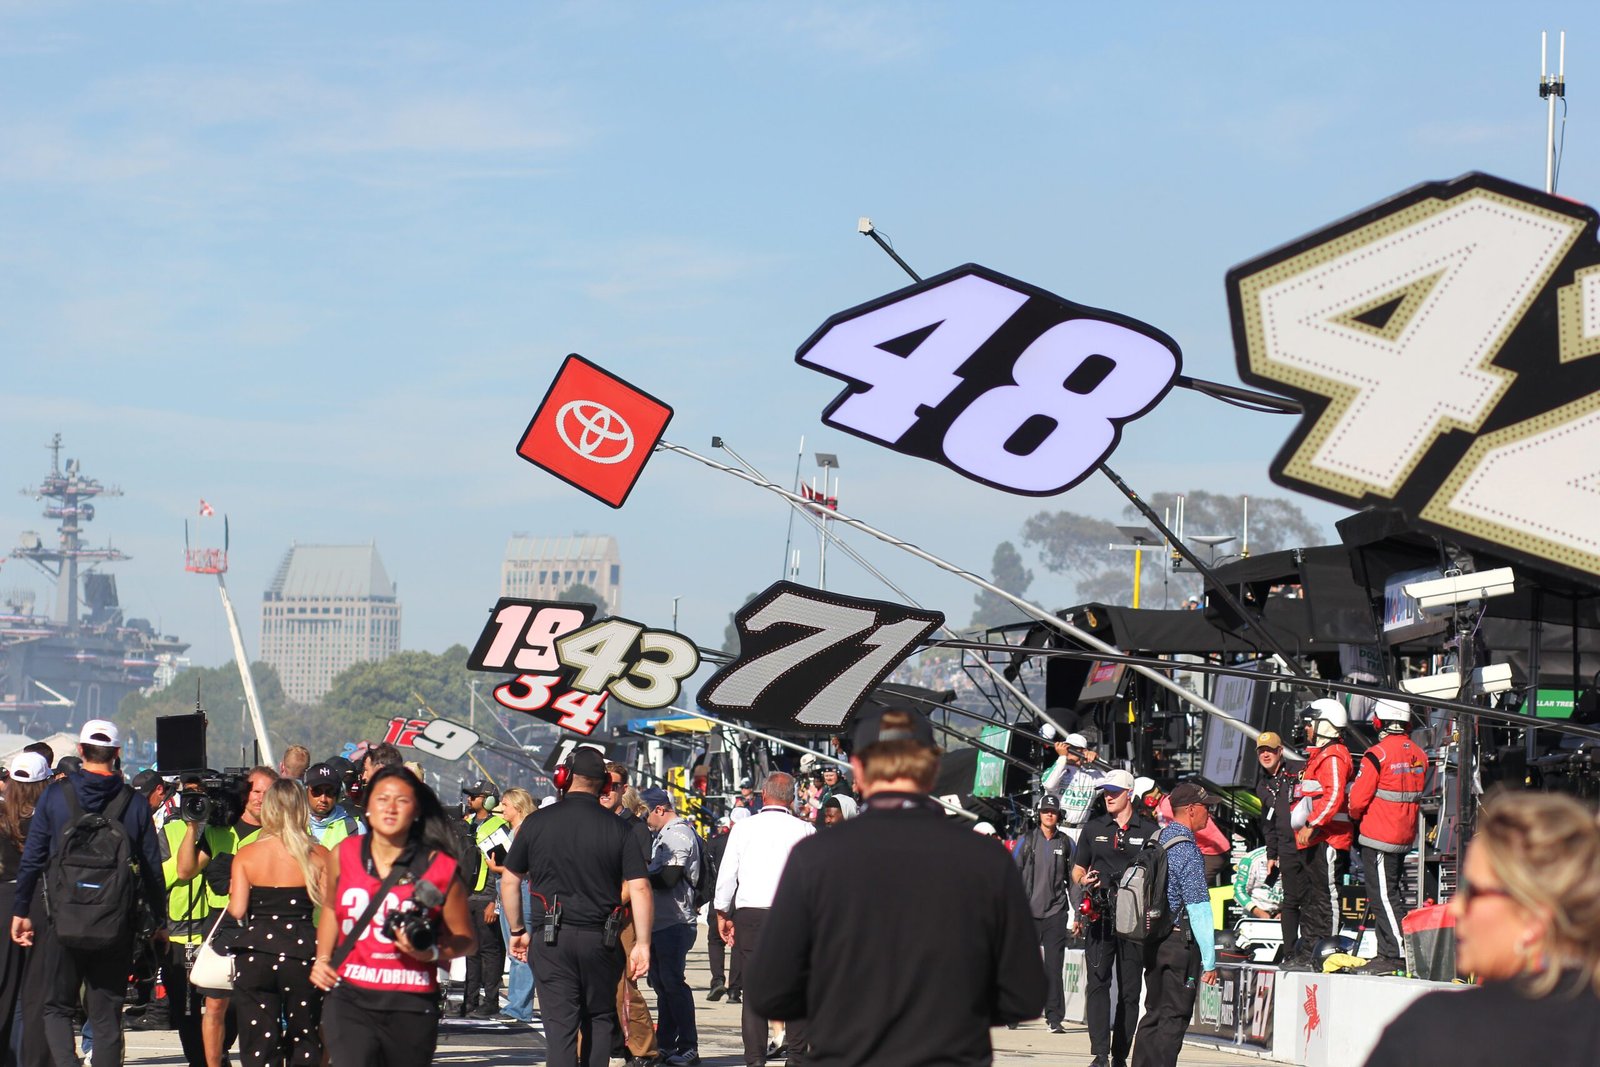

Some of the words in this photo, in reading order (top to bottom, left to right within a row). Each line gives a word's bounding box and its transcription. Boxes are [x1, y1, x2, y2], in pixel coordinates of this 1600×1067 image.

[803, 274, 1177, 492] 48
[481, 604, 585, 672] 19
[556, 618, 698, 709] 43
[708, 592, 934, 726] 71
[382, 717, 428, 748] 12
[494, 674, 609, 736] 34
[412, 718, 480, 761] 9
[555, 739, 614, 767] 1
[343, 963, 431, 987] TEAM/DRIVER
